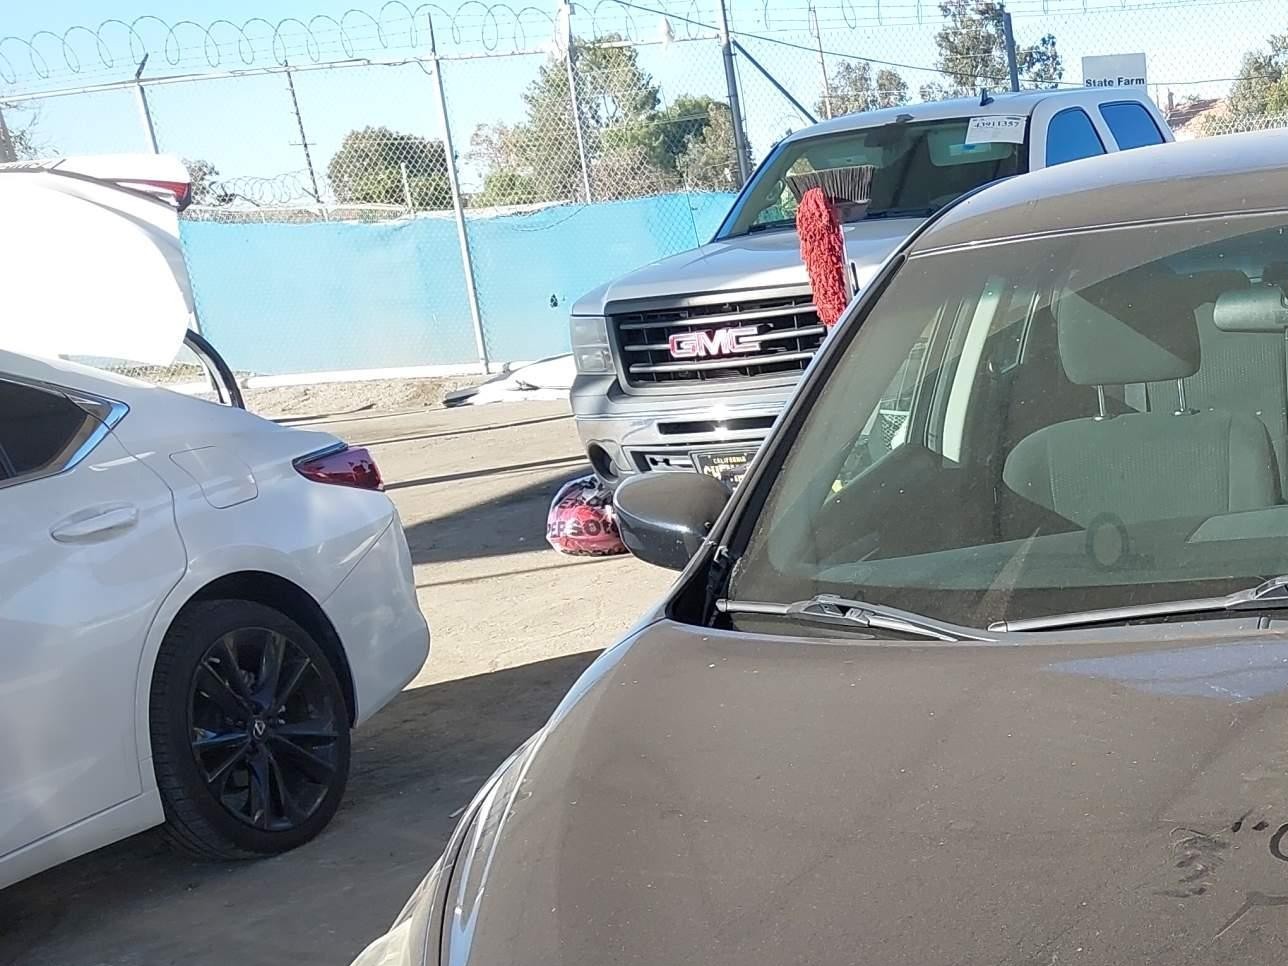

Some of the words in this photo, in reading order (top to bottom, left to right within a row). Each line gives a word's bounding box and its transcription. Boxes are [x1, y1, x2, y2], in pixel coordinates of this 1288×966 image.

[1085, 78, 1114, 88] State
[1117, 76, 1145, 86] Farm
[668, 326, 762, 358] GMC
